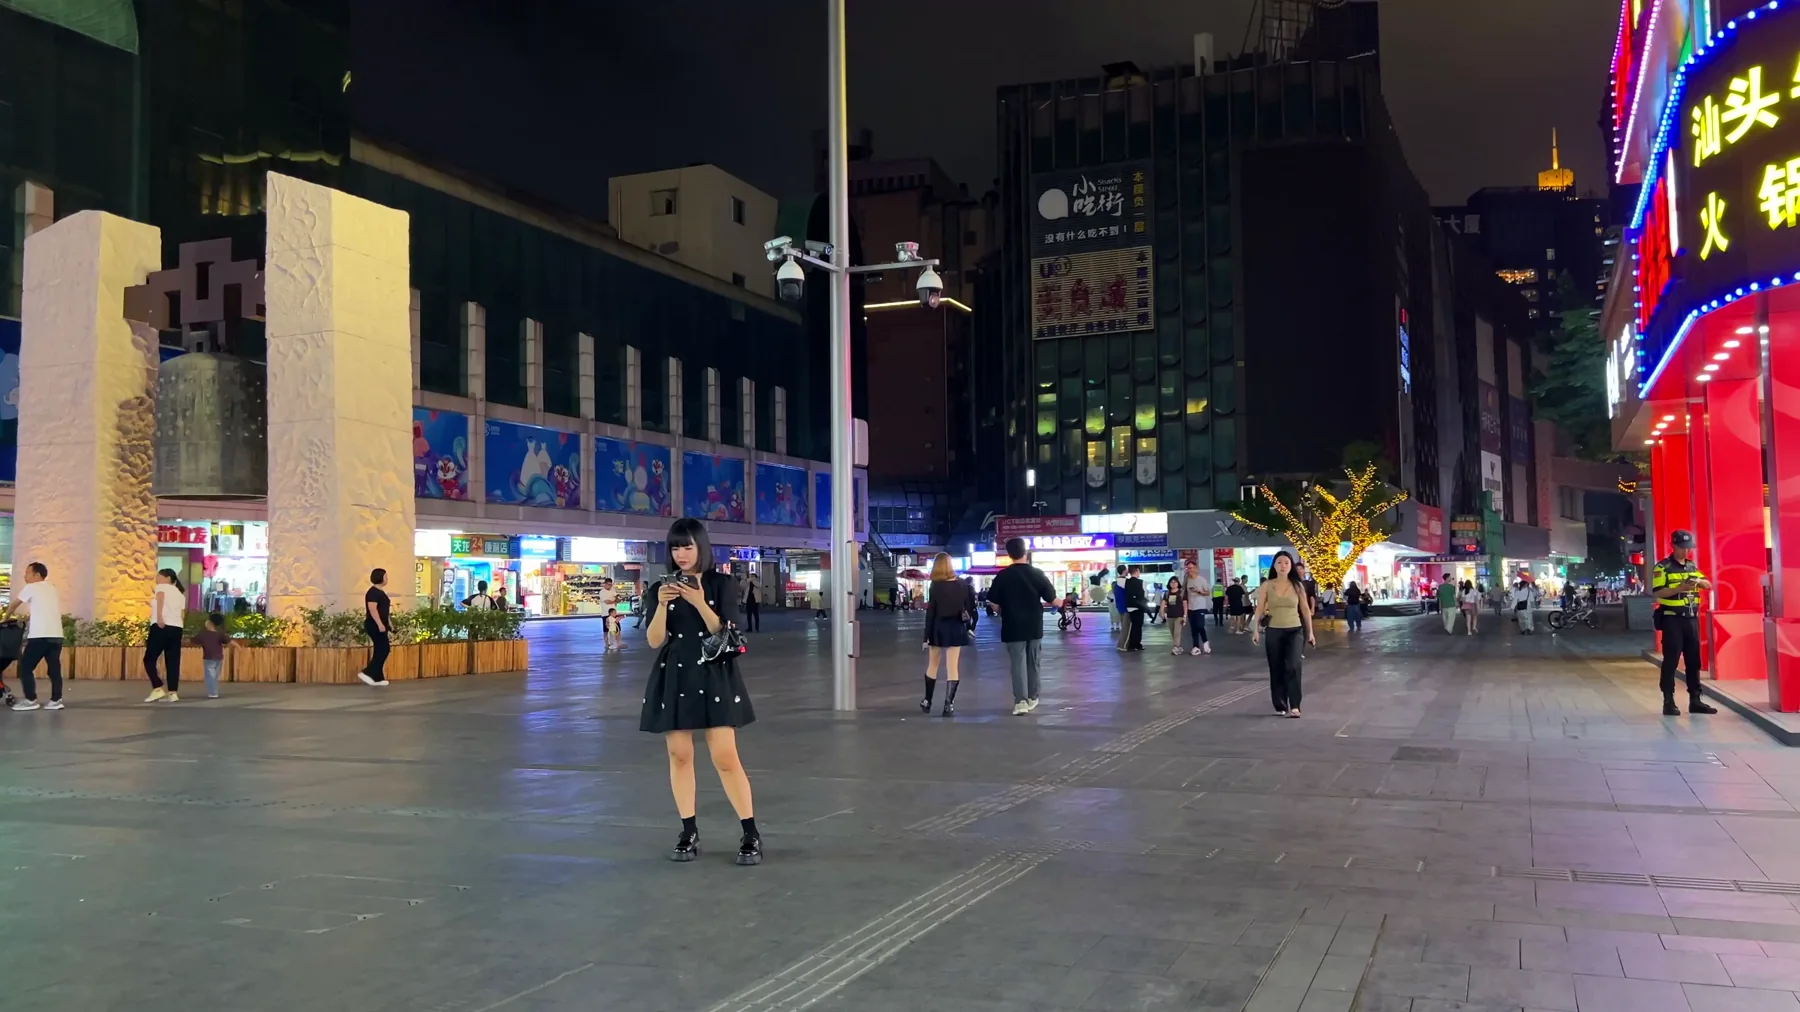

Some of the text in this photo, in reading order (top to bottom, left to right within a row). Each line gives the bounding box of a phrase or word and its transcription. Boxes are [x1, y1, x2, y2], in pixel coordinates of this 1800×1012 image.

[1691, 53, 1800, 168] 汕头
[1072, 174, 1096, 197] 小
[1097, 177, 1122, 185] Snacks
[1073, 192, 1125, 217] 吃街
[1700, 157, 1800, 261] 火锅
[1044, 224, 1127, 244] 没有什么吃不到！
[472, 537, 484, 548] 24
[484, 541, 508, 553] 便利店
